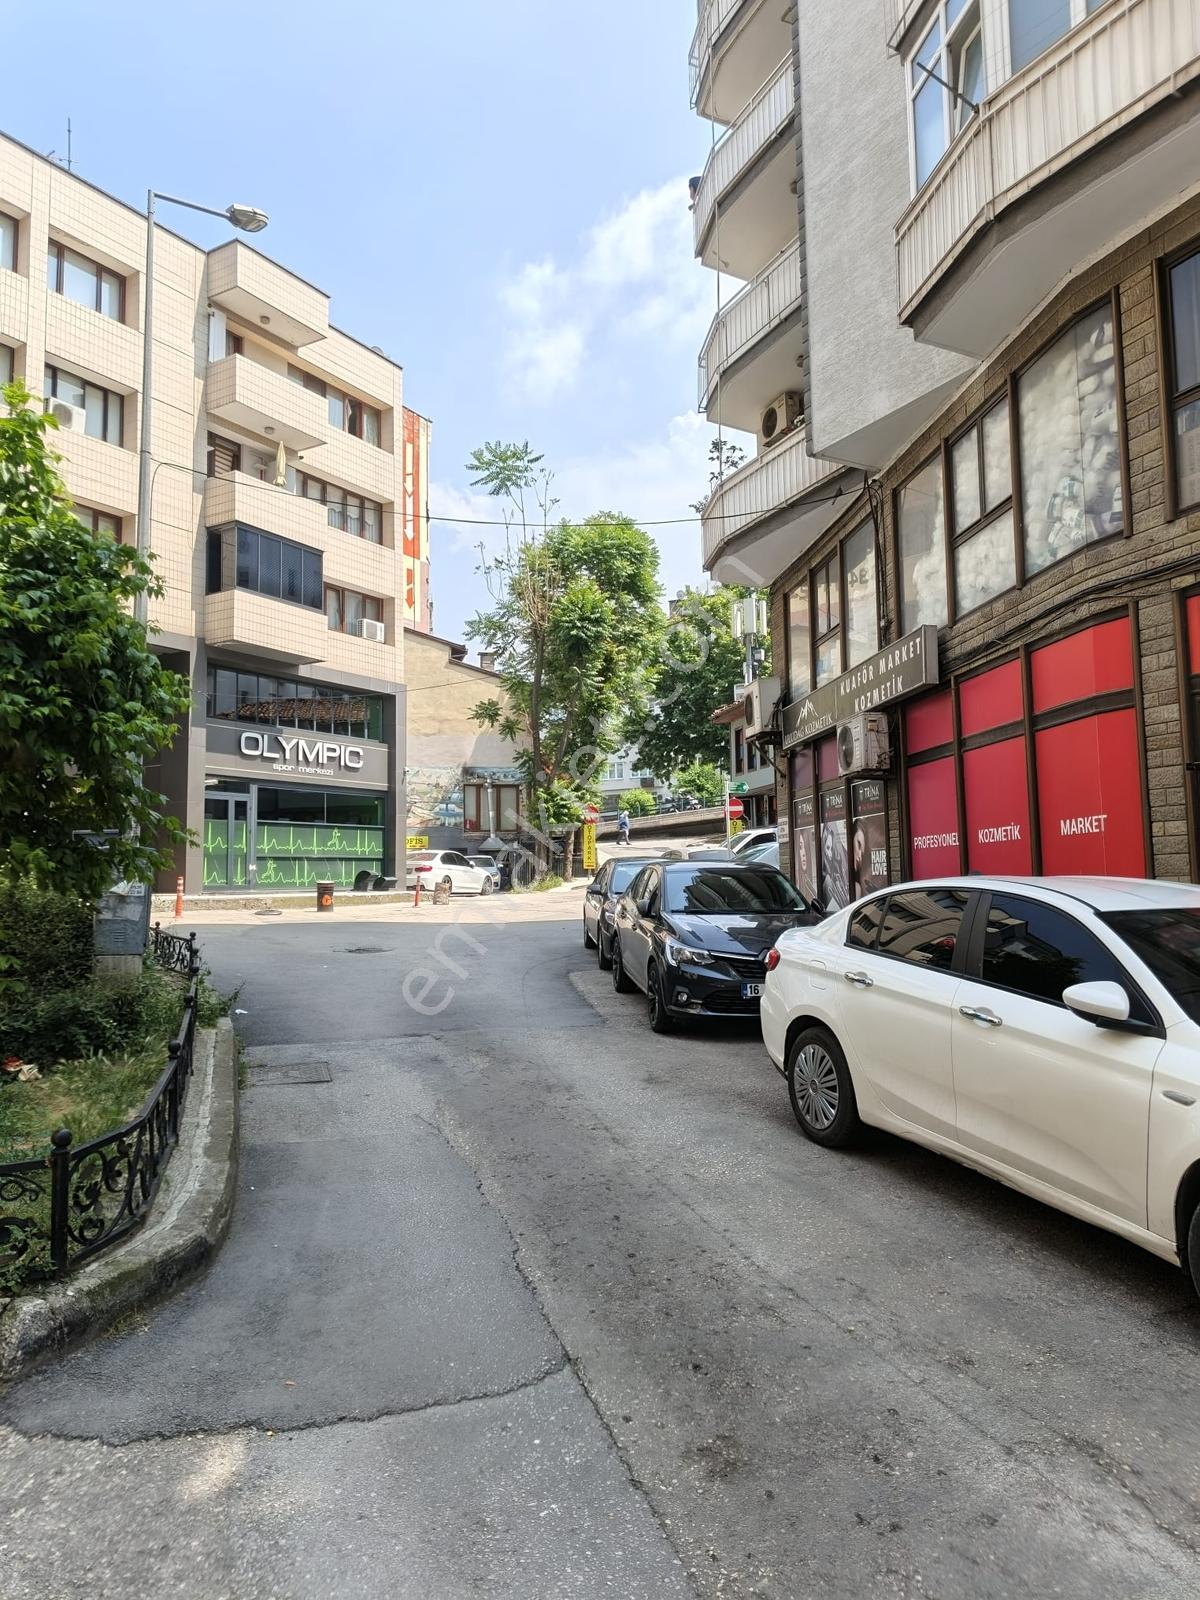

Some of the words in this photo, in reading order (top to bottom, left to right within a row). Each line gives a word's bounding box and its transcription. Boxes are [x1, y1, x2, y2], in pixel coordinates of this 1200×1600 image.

[841, 665, 874, 696] KUAFÖR
[879, 637, 921, 675] MARKET
[854, 674, 903, 712] KOZMETİK
[240, 731, 364, 768] OLYMPIC
[273, 763, 295, 772] spor
[298, 766, 334, 776] merkezi
[978, 821, 1021, 844] KOZMETİK
[1060, 815, 1107, 836] MARKET
[914, 832, 960, 850] PROFESYONEL
[871, 850, 887, 863] HAIR
[871, 863, 887, 875] LOVE
[748, 984, 760, 995] 16
